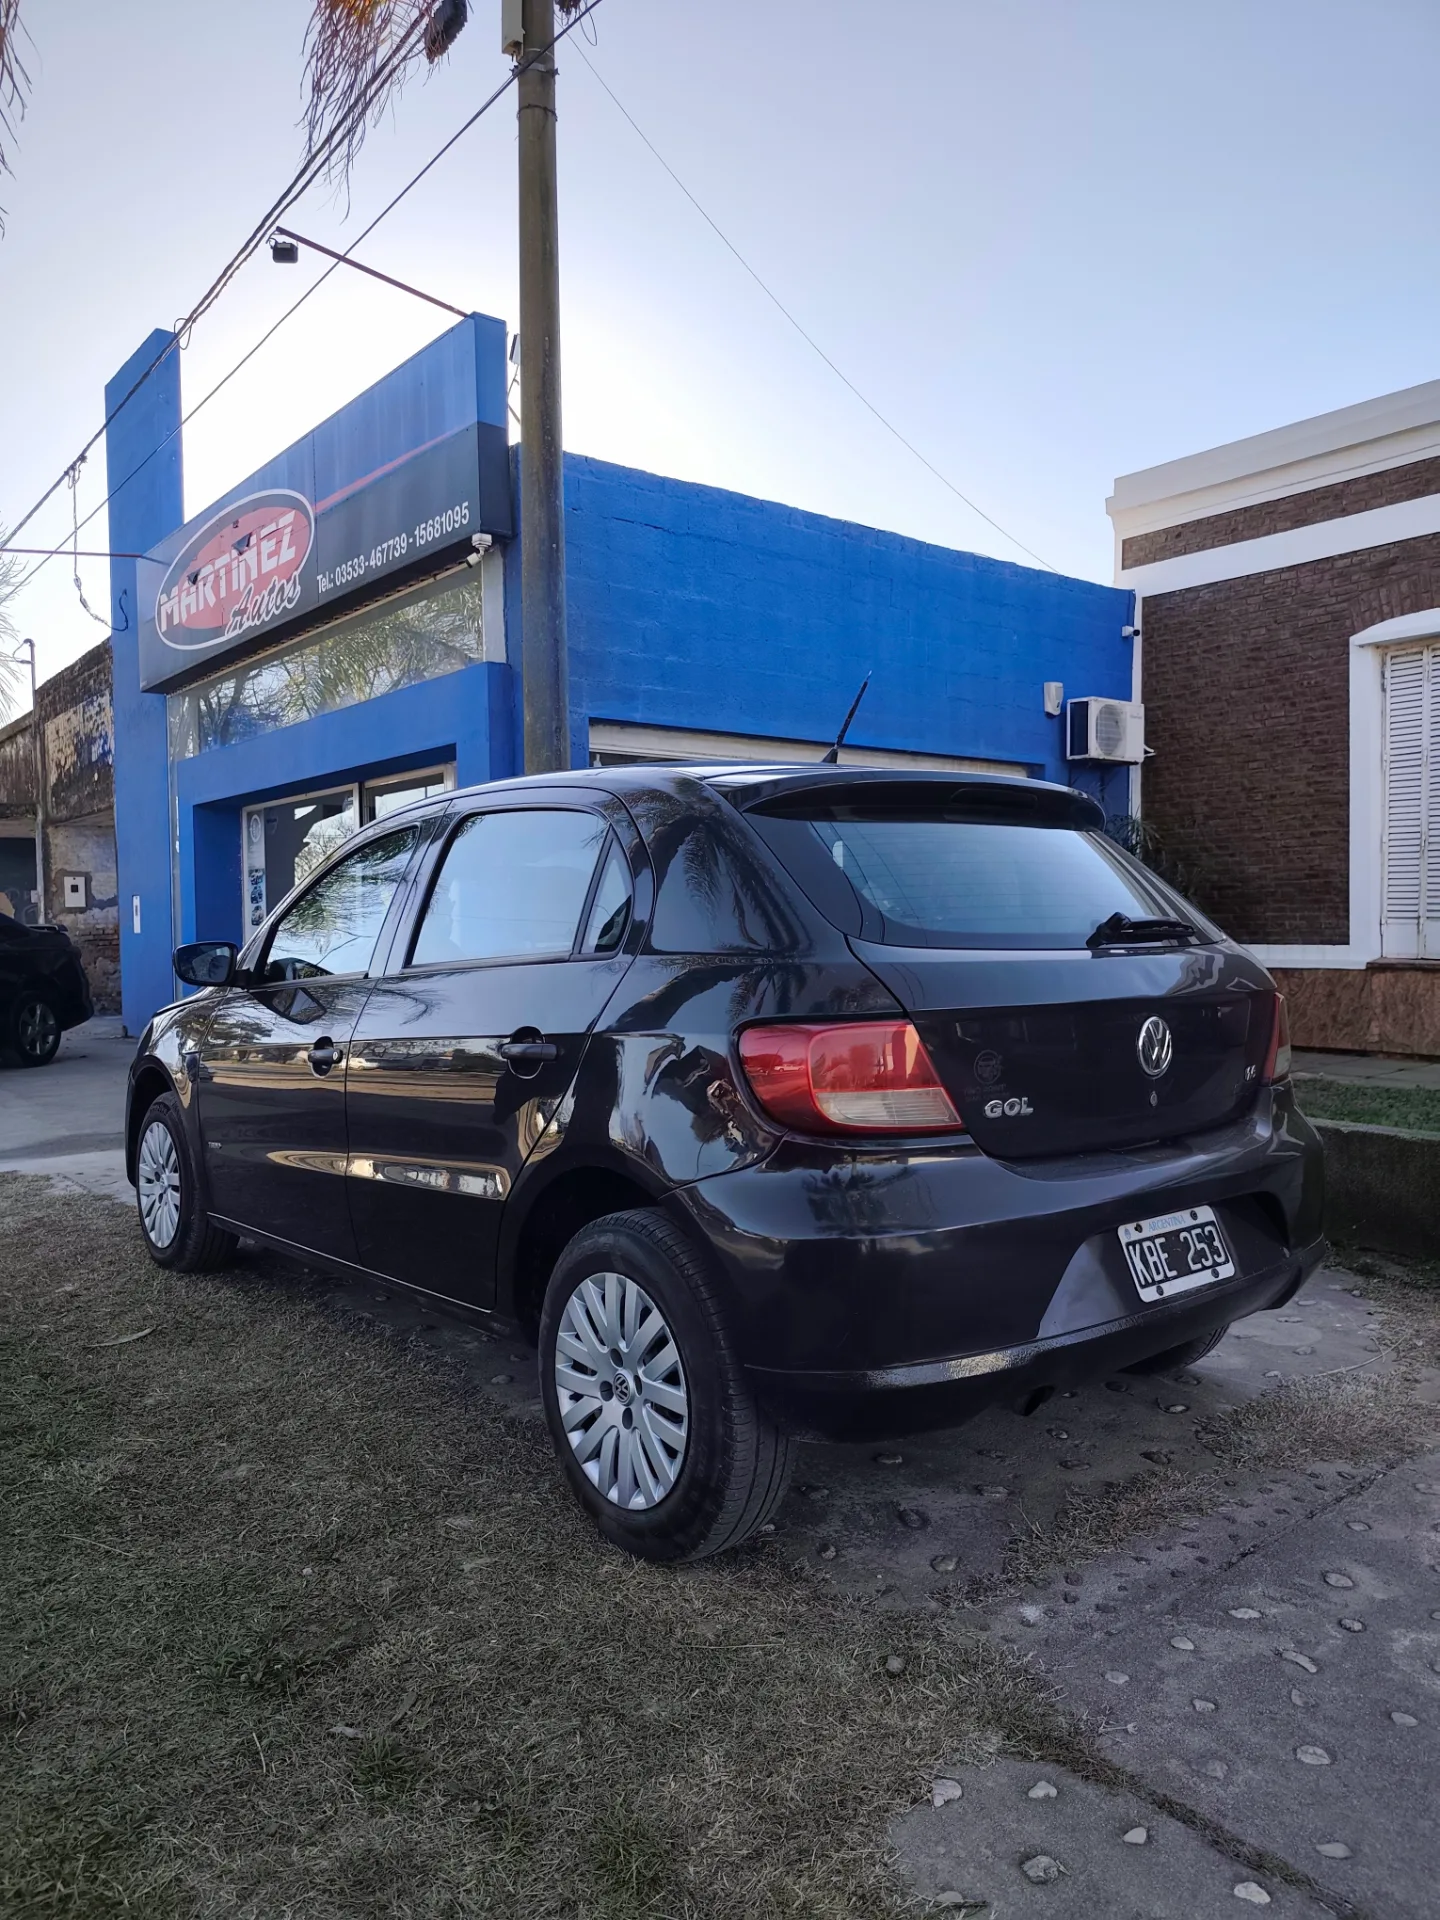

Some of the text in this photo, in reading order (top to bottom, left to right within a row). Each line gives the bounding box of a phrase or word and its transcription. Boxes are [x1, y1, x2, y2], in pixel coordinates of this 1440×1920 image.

[160, 509, 297, 633] MARTINEZ
[317, 571, 334, 594] Tel.:
[414, 501, 470, 547] 15681095
[984, 1097, 1034, 1118] GOL
[1148, 1215, 1186, 1233] ARGENTINA
[1128, 1225, 1226, 1286] KBE 253
